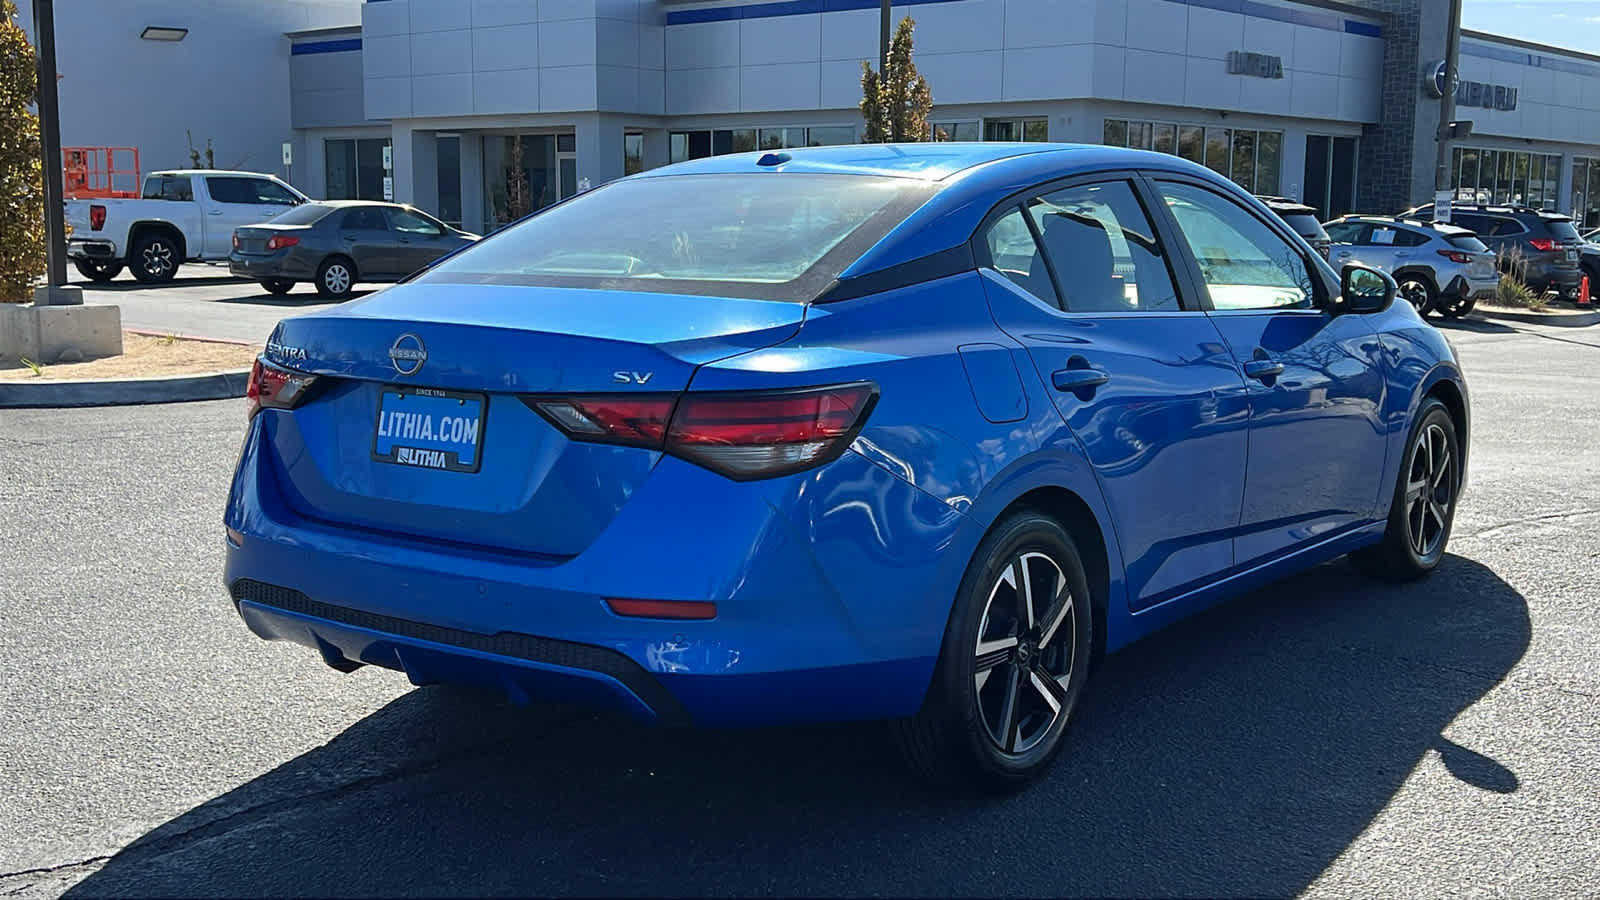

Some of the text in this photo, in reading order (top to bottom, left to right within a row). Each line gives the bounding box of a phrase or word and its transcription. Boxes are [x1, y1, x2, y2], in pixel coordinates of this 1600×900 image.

[1456, 80, 1518, 111] UBARU
[389, 348, 427, 360] NISSAN
[614, 371, 653, 384] SV
[378, 410, 479, 445] LITHIA.COM
[408, 448, 446, 468] LITHIA
